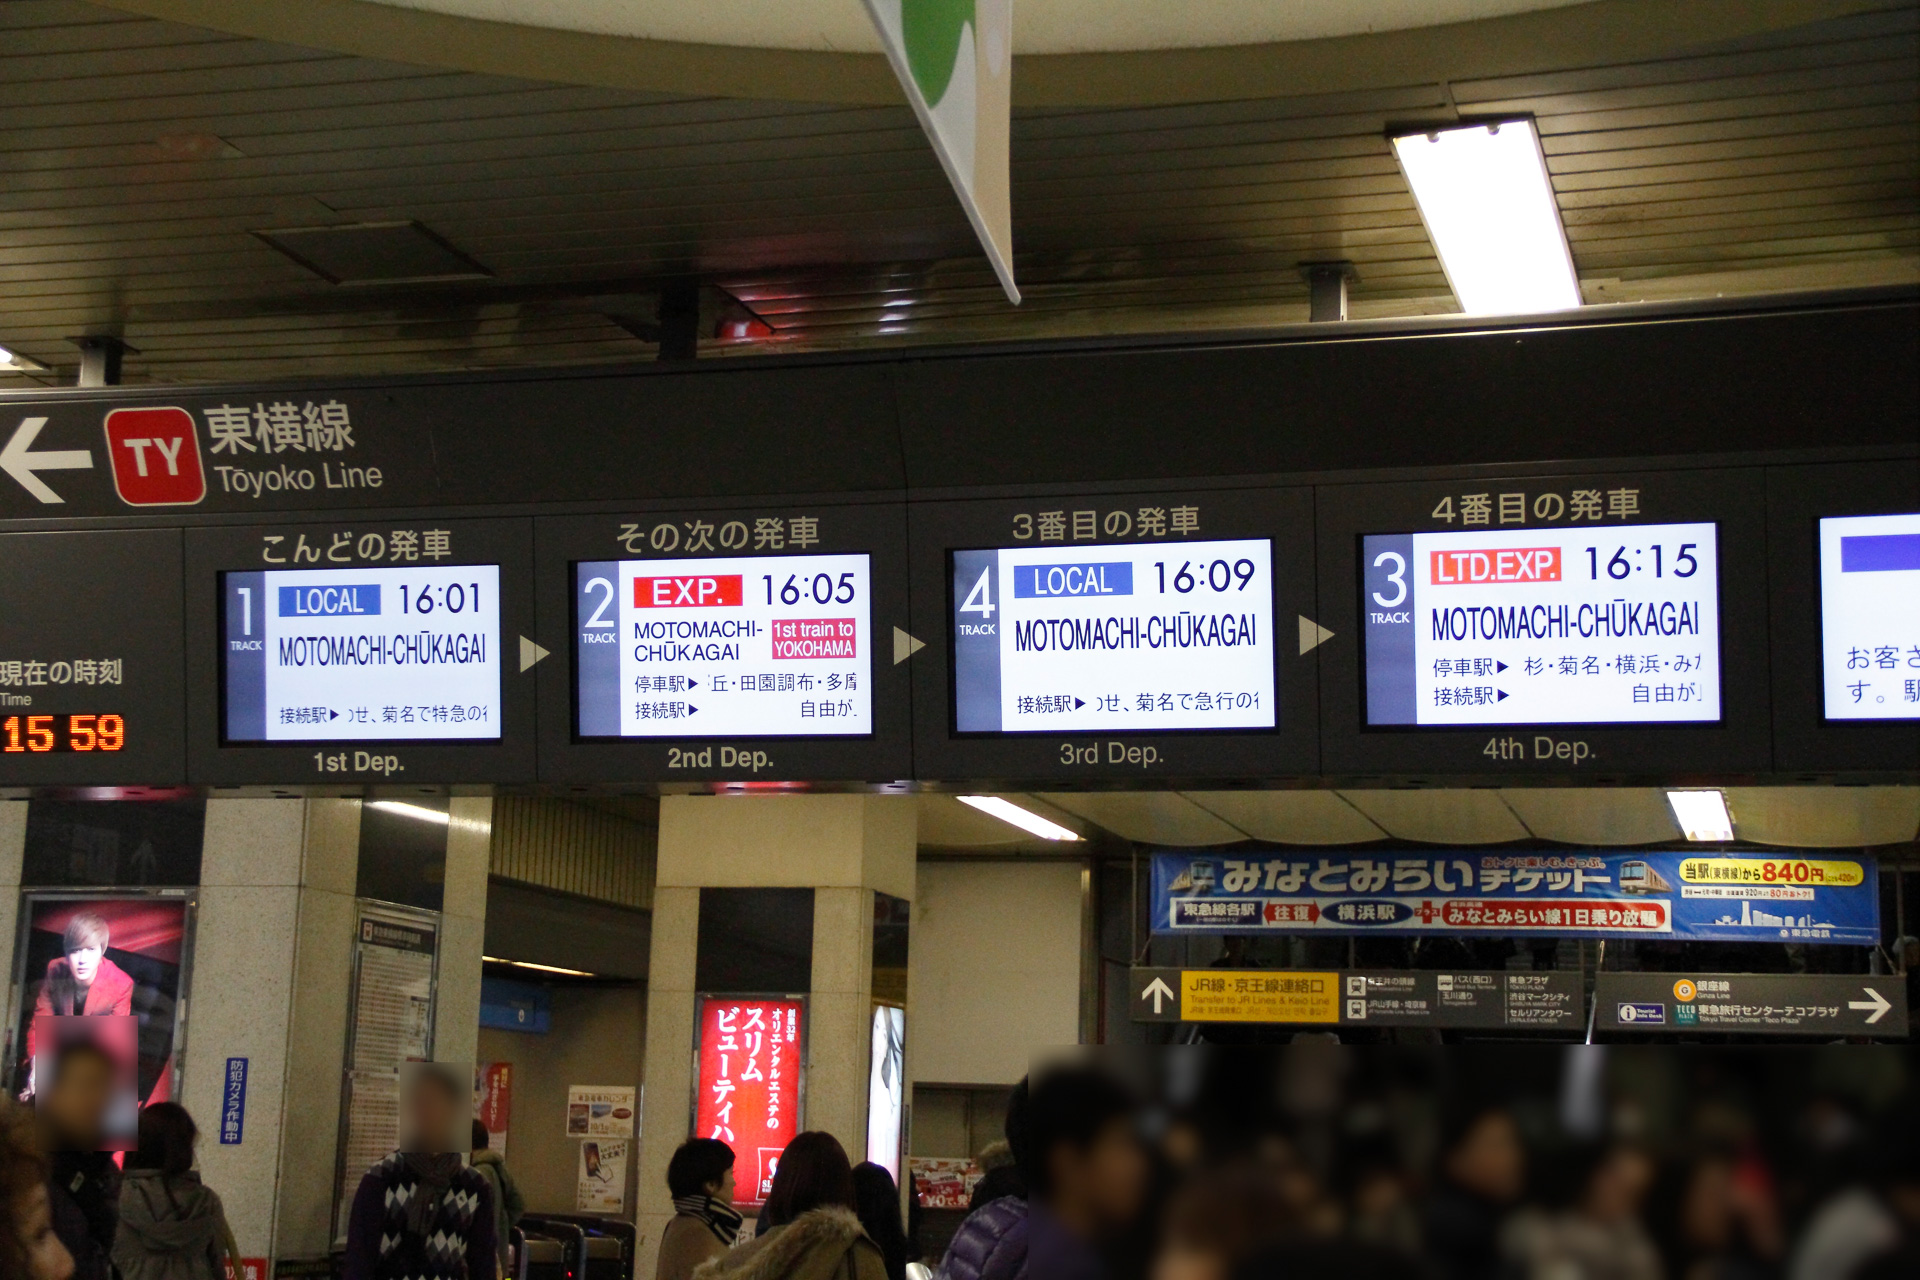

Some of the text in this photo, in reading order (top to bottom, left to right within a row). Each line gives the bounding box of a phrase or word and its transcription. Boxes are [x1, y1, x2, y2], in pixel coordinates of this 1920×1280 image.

[203, 400, 356, 454] 東横線
[124, 438, 183, 477] TY
[214, 463, 383, 499] Tōyoko Line
[1431, 487, 1640, 525] 4番目の発車
[616, 516, 820, 553] その次の発車
[1012, 505, 1200, 541] 3番目の発車
[262, 528, 452, 564] こんどの発車
[1437, 550, 1556, 582] LTD.EXP.
[1584, 543, 1698, 581] 16:15
[762, 573, 855, 605] 16:05
[1034, 566, 1113, 595] LOCAL
[1154, 558, 1255, 594] 16:09
[1372, 551, 1407, 608] 3
[296, 589, 364, 614] LOCAL
[399, 583, 480, 614] 16:01
[584, 577, 614, 628] 2
[652, 579, 723, 605] EXP.
[959, 566, 996, 618] 4
[237, 587, 252, 635] 1
[1370, 611, 1410, 625] TRACK
[582, 633, 616, 644] TRACK
[634, 620, 763, 639] MOTOMACHI-
[774, 622, 853, 638] 1st train to
[959, 624, 996, 635] TRACK
[1015, 611, 1256, 652] MOTOMACHI-CHŪKAGAI
[230, 640, 263, 651] TRACK
[279, 630, 486, 666] MOTOMACHI-CHŪKAGAI
[634, 641, 740, 662] CHŪKAGAI
[774, 640, 853, 657] YOKOHAMA
[0, 659, 122, 686] 現在の時刻
[1432, 657, 1492, 678] 停車駅
[635, 672, 857, 693] 停車駅 丘・田園調布・多摩
[1433, 681, 1702, 707] 接続駅 自由が
[0, 693, 32, 706] Time
[635, 698, 858, 720] 接続駅 自由が
[1017, 695, 1071, 714] 接続駅
[280, 706, 327, 725] 接続駅
[4, 715, 124, 752] 15 59
[668, 747, 774, 773] 2nd Dep.
[1060, 742, 1164, 768] 3rd Dep.
[1483, 736, 1597, 764] 4th Dep.
[314, 752, 405, 776] 1st Dep.
[1184, 903, 1255, 916] 東急線各駅
[1274, 905, 1309, 921] 往復
[1338, 904, 1395, 920] 横浜駅
[1190, 979, 1324, 993] JR線・京王線連絡口
[1509, 976, 1549, 985] 東急プラザ
[1697, 981, 1730, 992] 銀座線
[1191, 995, 1224, 1004] Transfer
[1227, 996, 1235, 1004] to
[1238, 996, 1250, 1004] JR
[1253, 996, 1276, 1004] Lines
[1311, 996, 1330, 1005] Line
[1509, 993, 1570, 1002] 渋谷マークシティ
[1676, 1005, 1696, 1014] TECO
[1509, 1009, 1572, 1017] セルリアンタワー
[741, 1007, 766, 1081] スリム
[766, 1008, 782, 1129] オリエンタルエステの
[225, 1060, 244, 1142] 防犯カメラ作動中
